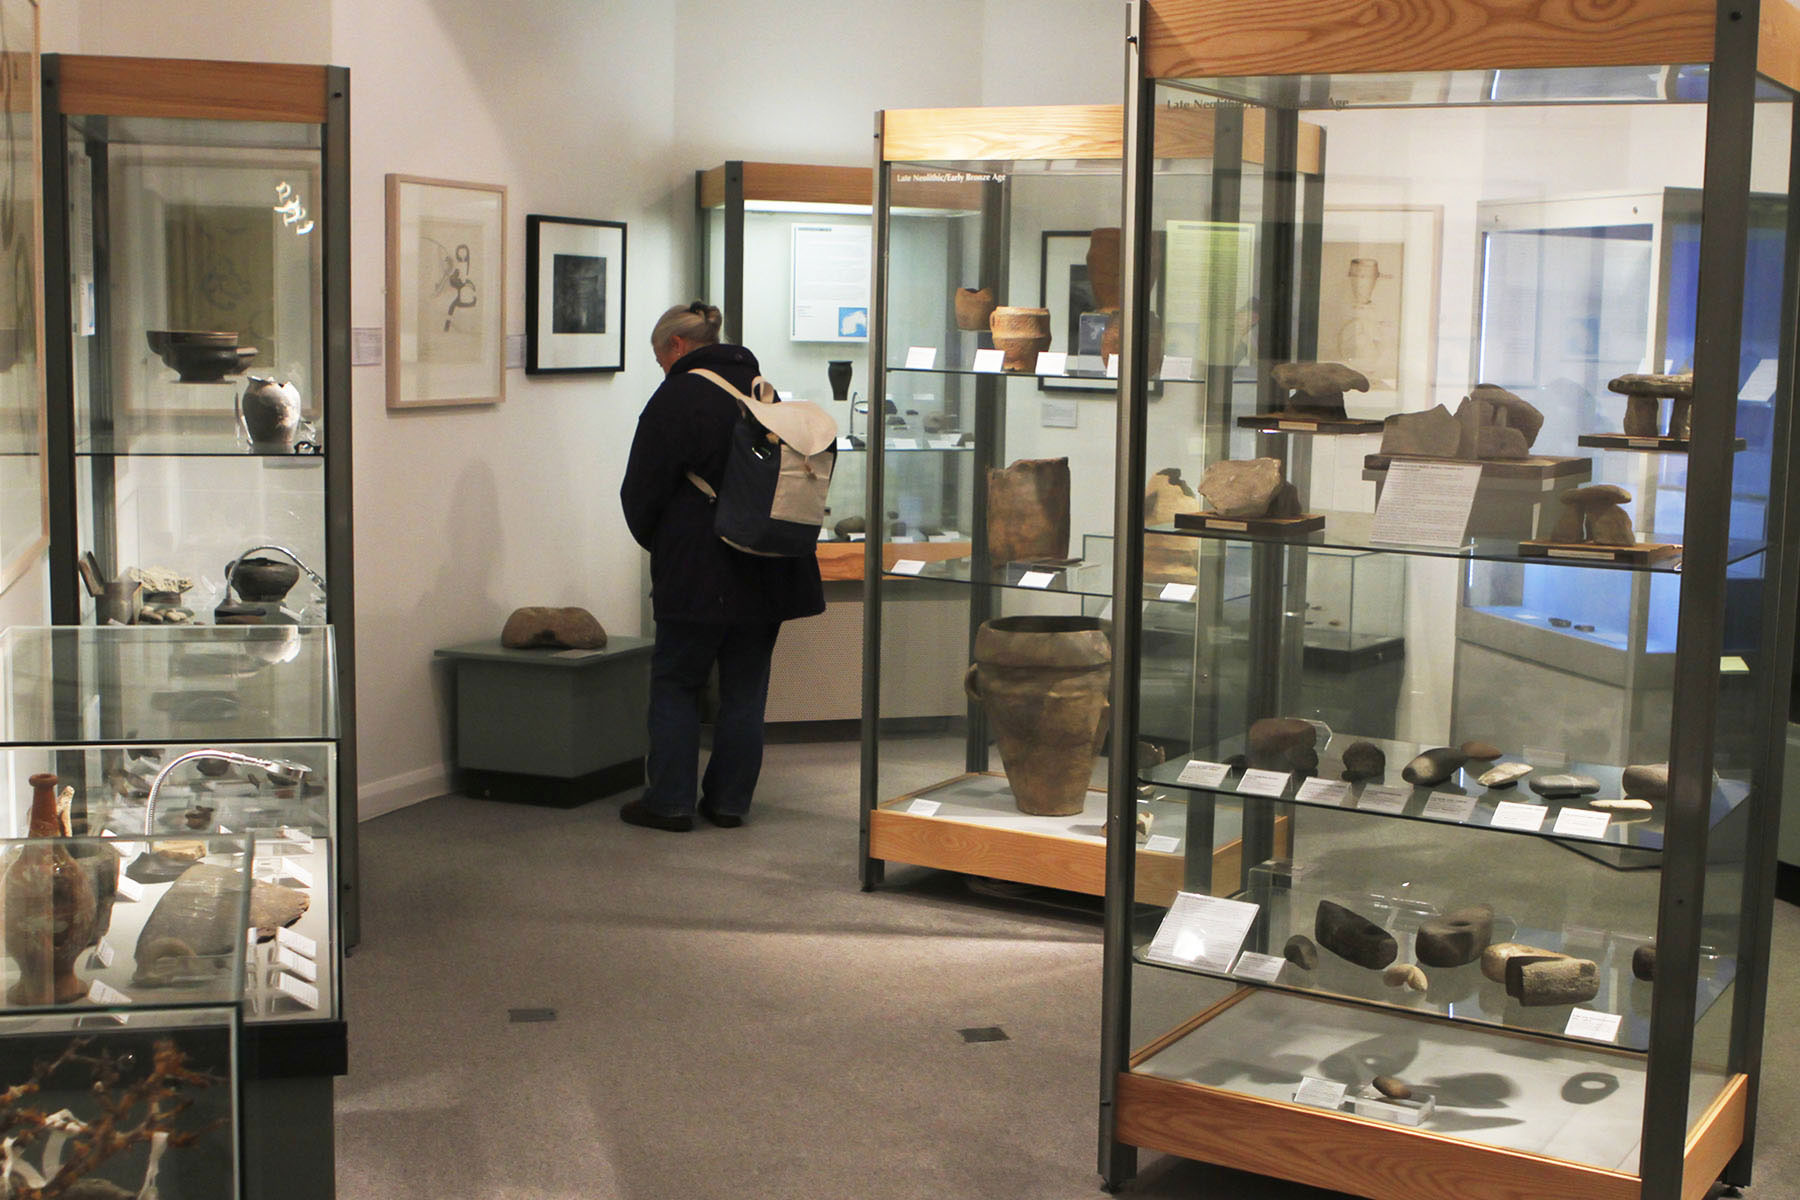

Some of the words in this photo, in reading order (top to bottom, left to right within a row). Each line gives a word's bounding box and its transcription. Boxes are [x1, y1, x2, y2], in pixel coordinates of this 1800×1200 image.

[1167, 99, 1189, 110] Late
[897, 174, 911, 182] Late
[913, 173, 964, 183] Neolithic/Early
[966, 173, 990, 182] Bronze
[992, 173, 1006, 183] Age
